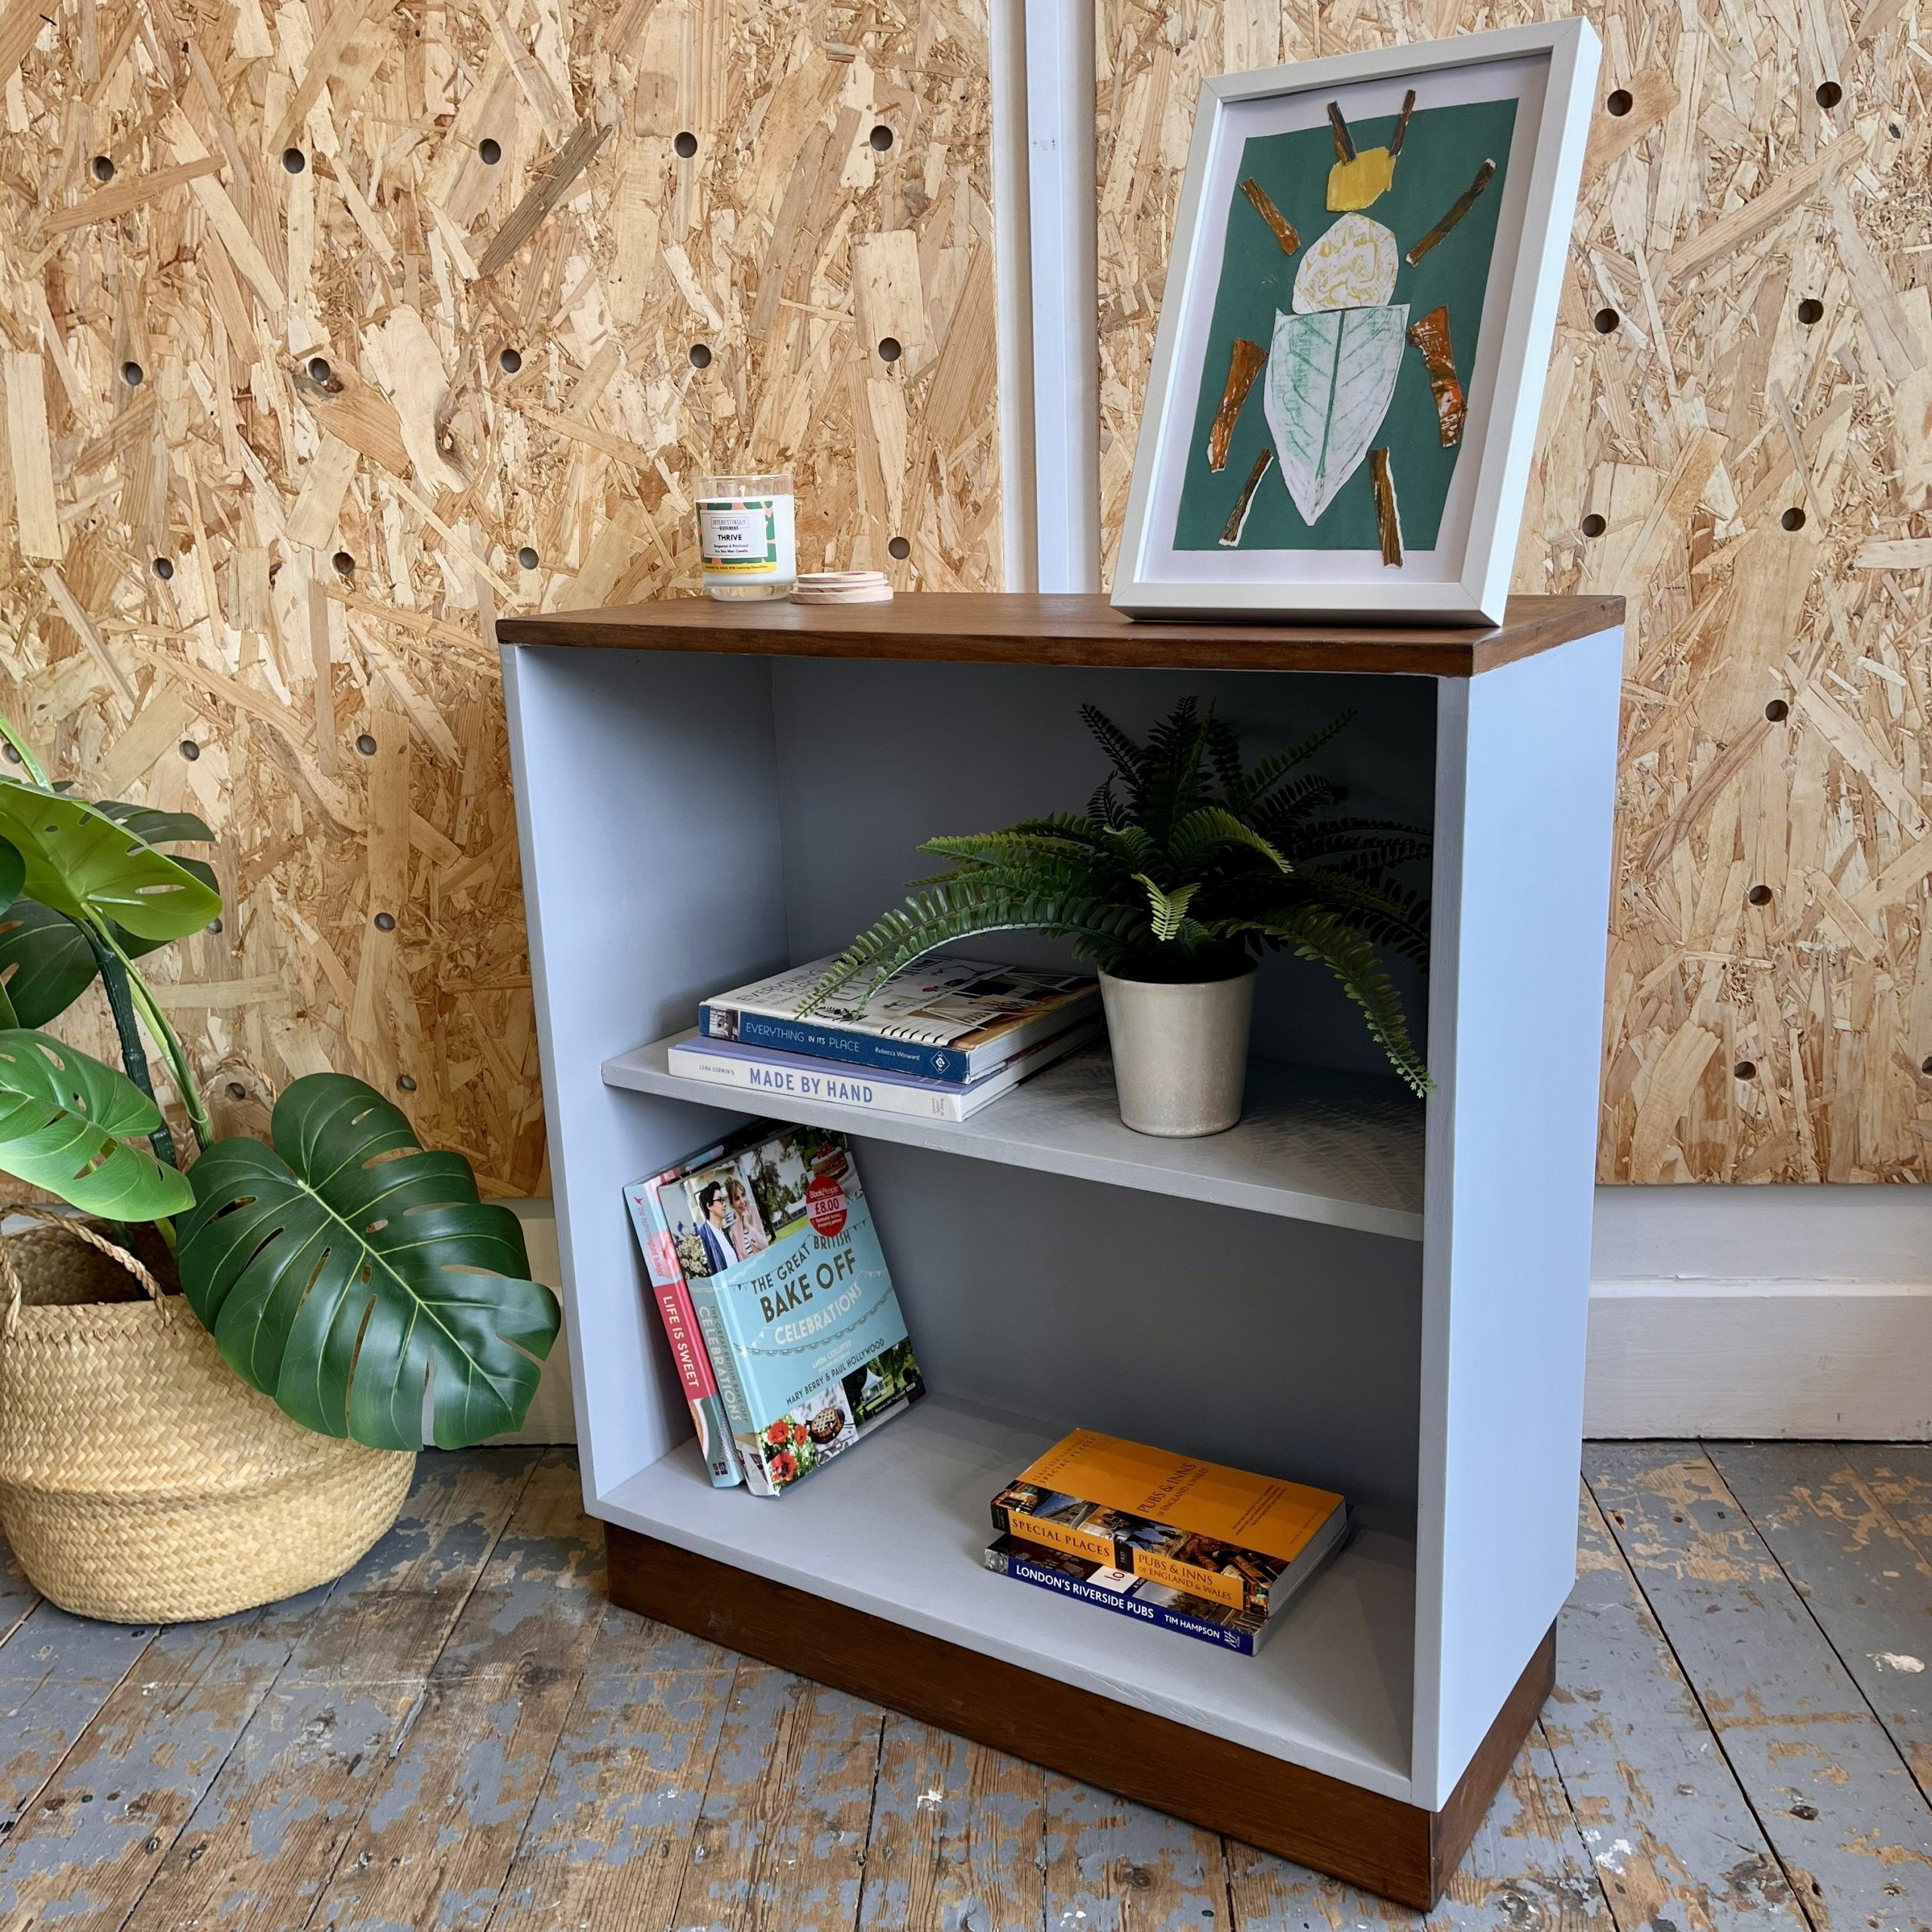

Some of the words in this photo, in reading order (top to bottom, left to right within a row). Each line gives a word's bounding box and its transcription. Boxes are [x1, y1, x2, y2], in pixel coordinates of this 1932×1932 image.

[746, 1023, 804, 1042] EVERYTHING
[817, 1036, 826, 1044] ITS
[829, 1037, 860, 1052] PLACE
[875, 1047, 896, 1057] Rebecca
[896, 1051, 920, 1061] Winward
[749, 1068, 795, 1091] MADE
[801, 1076, 820, 1094] BY
[827, 1080, 872, 1103] HAND
[815, 1198, 839, 1214] £8.00
[751, 1273, 774, 1294] THE
[777, 1243, 810, 1280] GREAT
[814, 1229, 851, 1249] BRITISH
[760, 1274, 814, 1323] BAKE
[816, 1248, 855, 1290] OFF
[774, 1281, 862, 1345] CELEBRATIONS
[663, 1296, 680, 1324] LIFE
[672, 1327, 684, 1340] IS
[678, 1343, 700, 1388] SWEET
[699, 1306, 742, 1421] CELEBRATIONS
[715, 1323, 727, 1349] GREAT
[734, 1383, 743, 1403] BAKE
[741, 1406, 749, 1423] OFF
[786, 1389, 803, 1406] MARY
[804, 1377, 824, 1395] BERRY
[825, 1373, 830, 1381] &
[831, 1363, 847, 1377] PAUL
[847, 1338, 884, 1367] HOLLYWOOD
[1137, 1491, 1165, 1513] PUBS
[1166, 1463, 1196, 1484] INNS
[1161, 1486, 1189, 1511] ENGLAND
[1189, 1467, 1209, 1483] WALES
[1013, 1518, 1061, 1542] SPECIAL
[1066, 1535, 1110, 1557] PLACES
[1017, 1565, 1070, 1592] LONDON'S
[1072, 1583, 1124, 1609] RIVERSIDE
[1127, 1601, 1154, 1618] PUBS
[1138, 1554, 1167, 1572] PUBS
[1170, 1564, 1179, 1575] &
[1183, 1567, 1213, 1585] INNS
[1149, 1568, 1193, 1589] ENGLAND
[1203, 1588, 1232, 1601] WALES
[1164, 1614, 1179, 1626] TIM
[1180, 1620, 1220, 1639] HAMPSON
